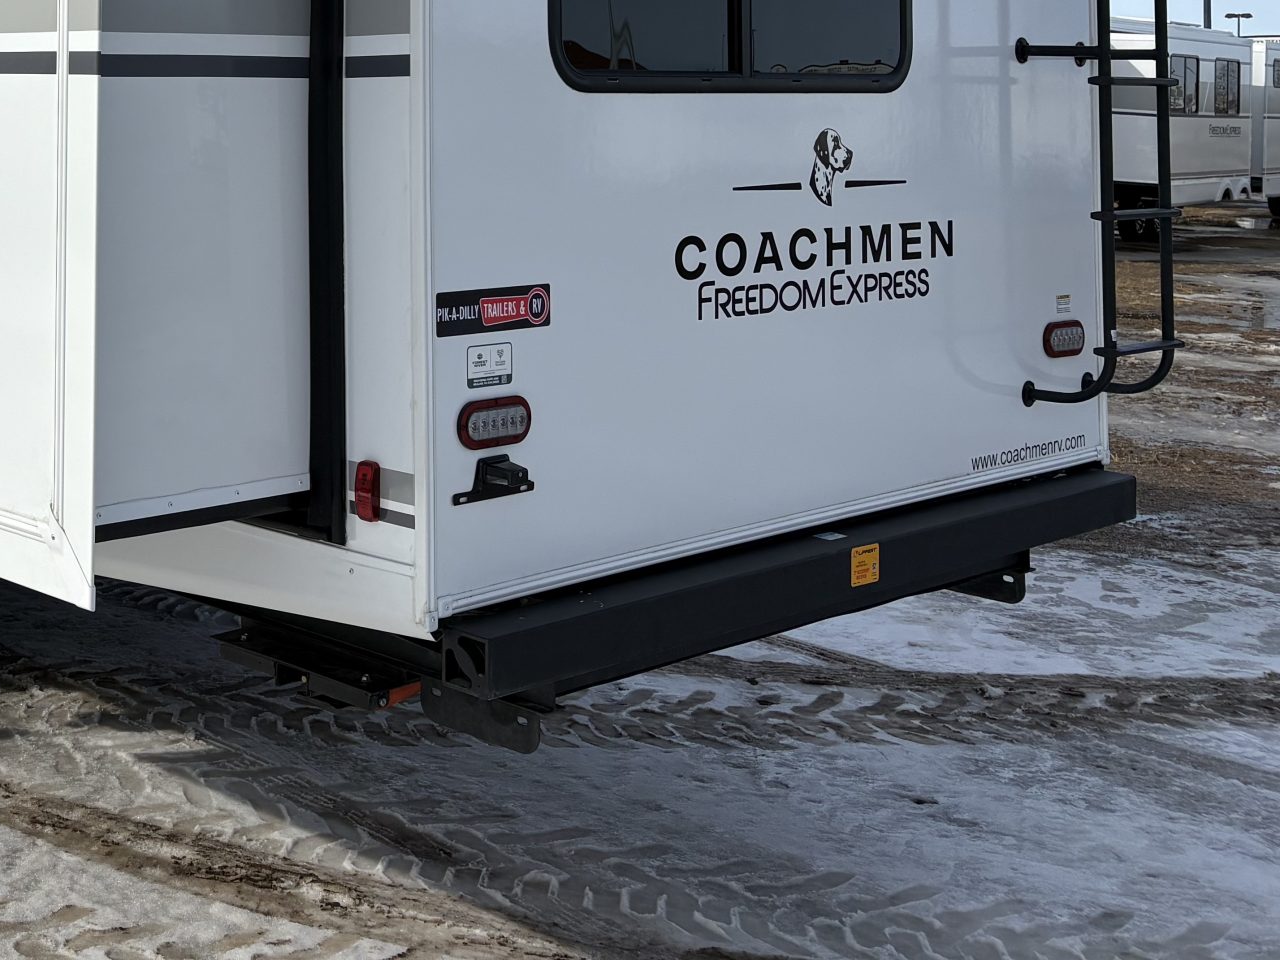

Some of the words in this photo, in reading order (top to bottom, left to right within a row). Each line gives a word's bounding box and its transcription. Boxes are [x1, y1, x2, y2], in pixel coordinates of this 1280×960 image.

[674, 219, 954, 281] COACHMEN
[437, 304, 480, 323] PIK-A-DILLY
[483, 300, 517, 319] TRAILERS
[519, 300, 526, 315] &
[532, 298, 542, 314] RV
[971, 433, 1086, 471] www.coachmenrv.com
